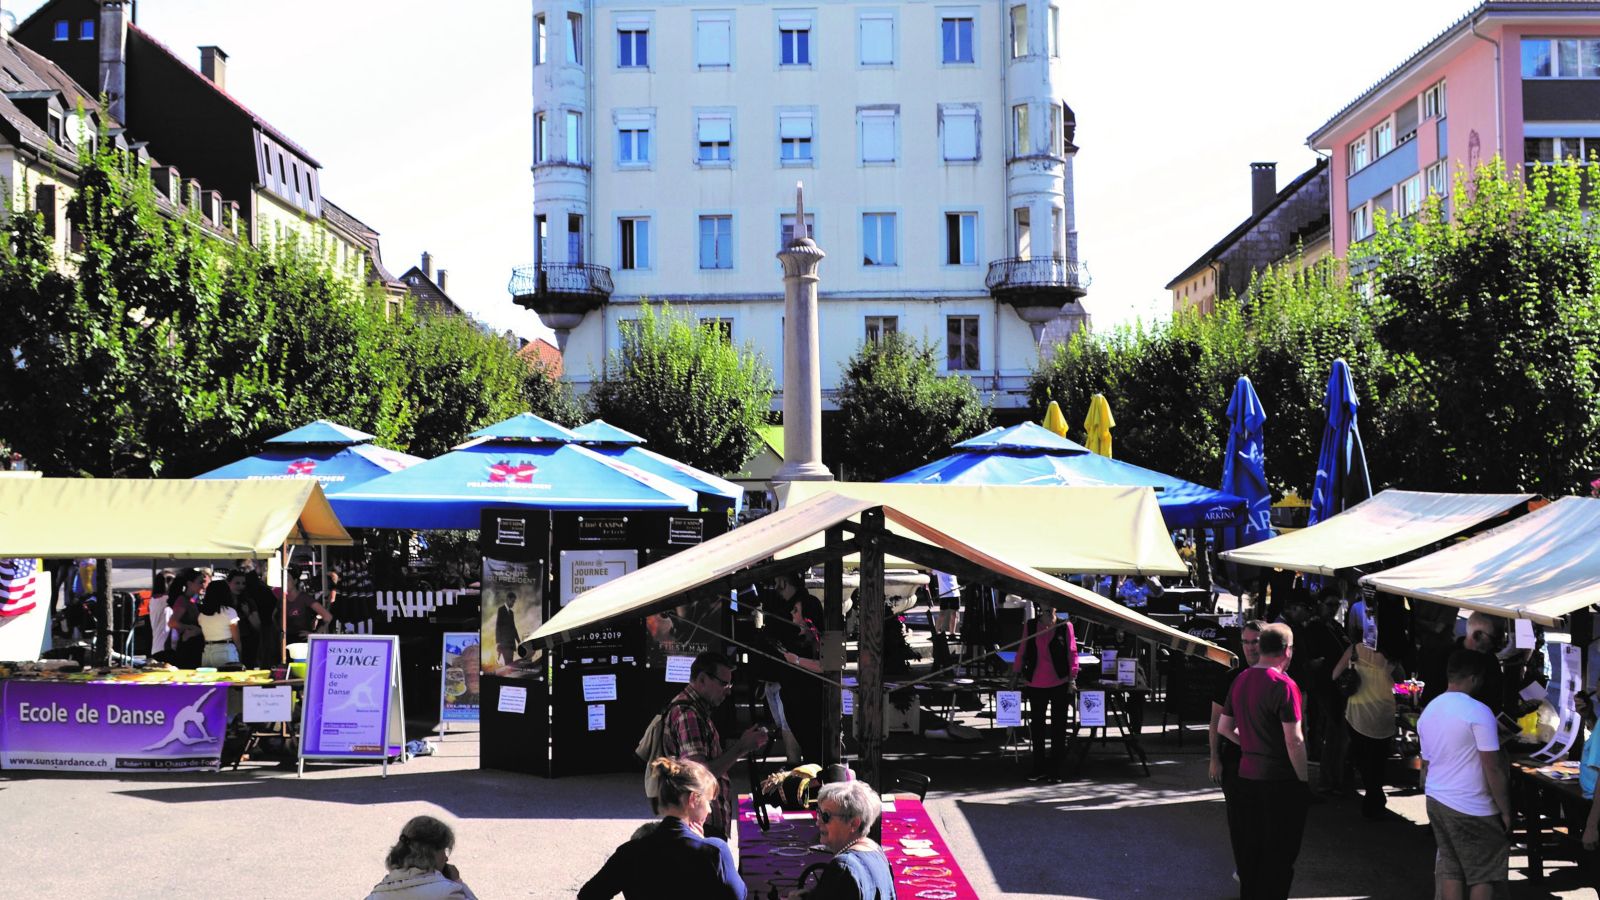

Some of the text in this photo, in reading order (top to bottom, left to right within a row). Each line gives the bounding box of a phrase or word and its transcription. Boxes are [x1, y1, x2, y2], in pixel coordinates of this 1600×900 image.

[1204, 511, 1236, 521] ARKINA
[574, 577, 585, 585] DU
[335, 655, 381, 667] DANCE
[328, 671, 349, 680] Ecole
[328, 680, 338, 688] de
[327, 688, 351, 696] Danse
[19, 702, 165, 725] Ecole de Danse
[9, 757, 108, 767] www.sunstardance.ch
